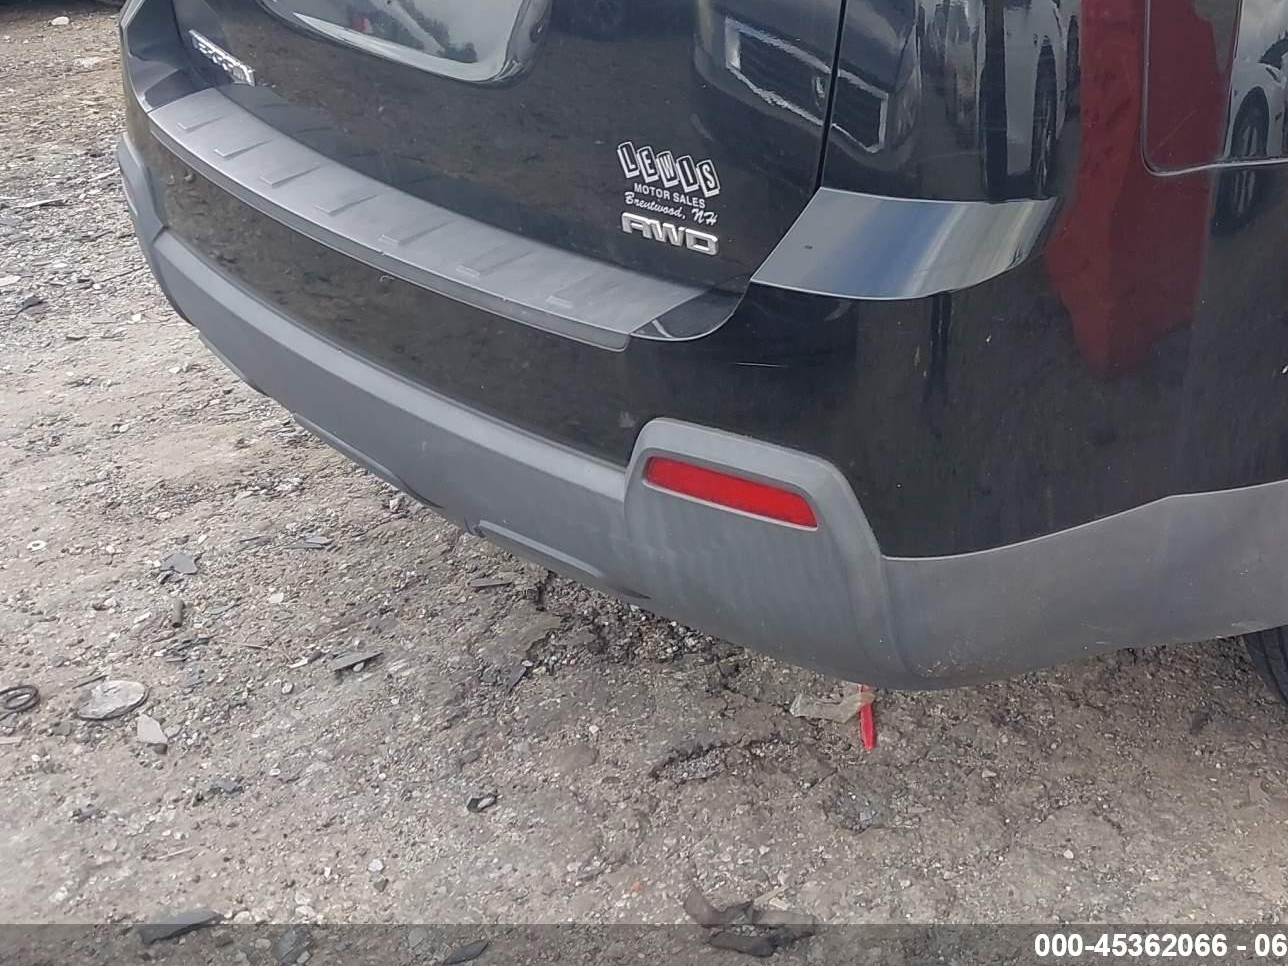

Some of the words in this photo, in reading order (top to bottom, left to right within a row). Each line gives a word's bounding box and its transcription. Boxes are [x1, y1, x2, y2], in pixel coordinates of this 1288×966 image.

[616, 141, 721, 198] LEWIS
[624, 191, 686, 220] Brentwood,
[691, 208, 719, 226] NH
[633, 182, 671, 201] MOTOR
[672, 192, 706, 209] SALES
[621, 212, 719, 256] AWD
